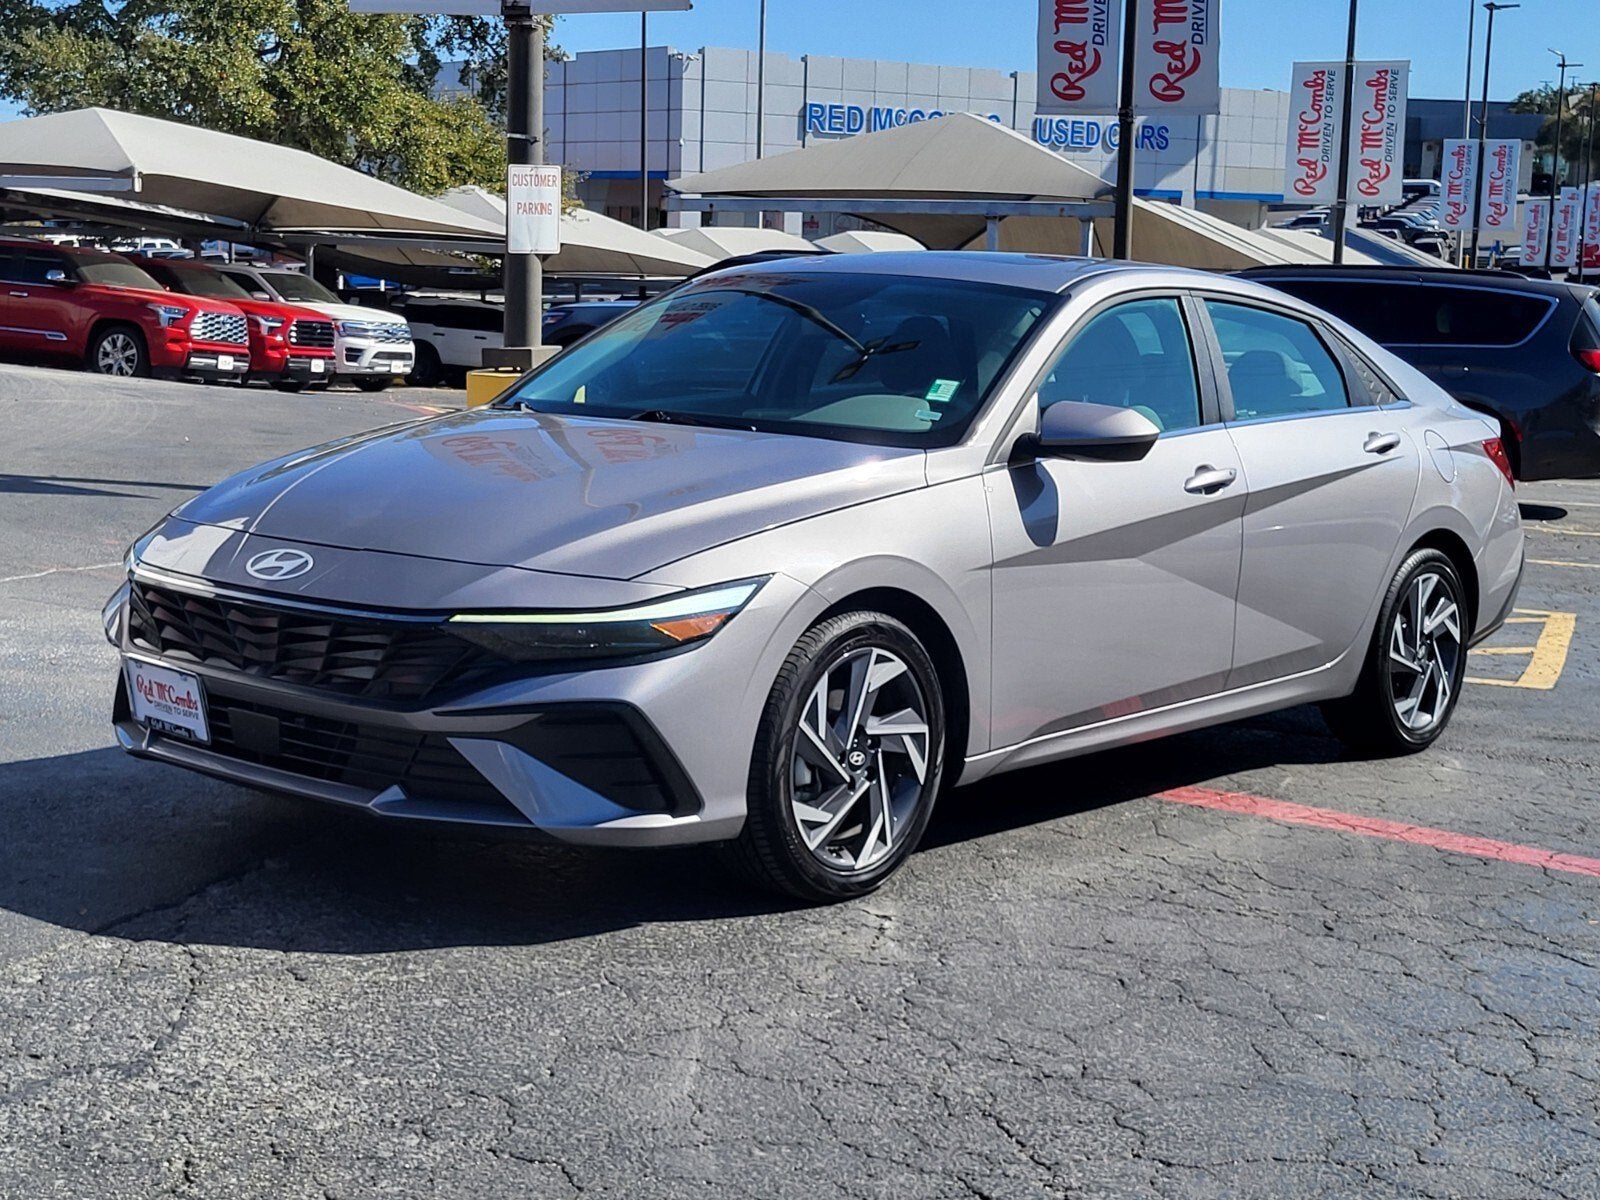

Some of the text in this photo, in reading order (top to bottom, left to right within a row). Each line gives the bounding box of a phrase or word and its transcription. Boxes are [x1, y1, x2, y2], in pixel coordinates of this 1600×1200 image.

[1051, 40, 1101, 101] Red
[1149, 40, 1201, 102] Red
[807, 102, 865, 133] RED
[1036, 117, 1100, 147] USED
[1108, 122, 1170, 151] CRS
[1293, 69, 1327, 196] Red McCombs
[1321, 69, 1336, 163] DRIVEN TO SERVE
[1357, 69, 1391, 196] Red McCombs
[1384, 68, 1400, 163] DRIVEN TO SERVE
[512, 173, 558, 188] CUSTOMER
[516, 202, 553, 216] PARKING
[1445, 144, 1467, 225] Red McCombs
[1485, 144, 1508, 226] Red McCombs
[136, 674, 199, 711] Red McCombs
[173, 706, 181, 716] TO
[182, 708, 199, 720] SERVE
